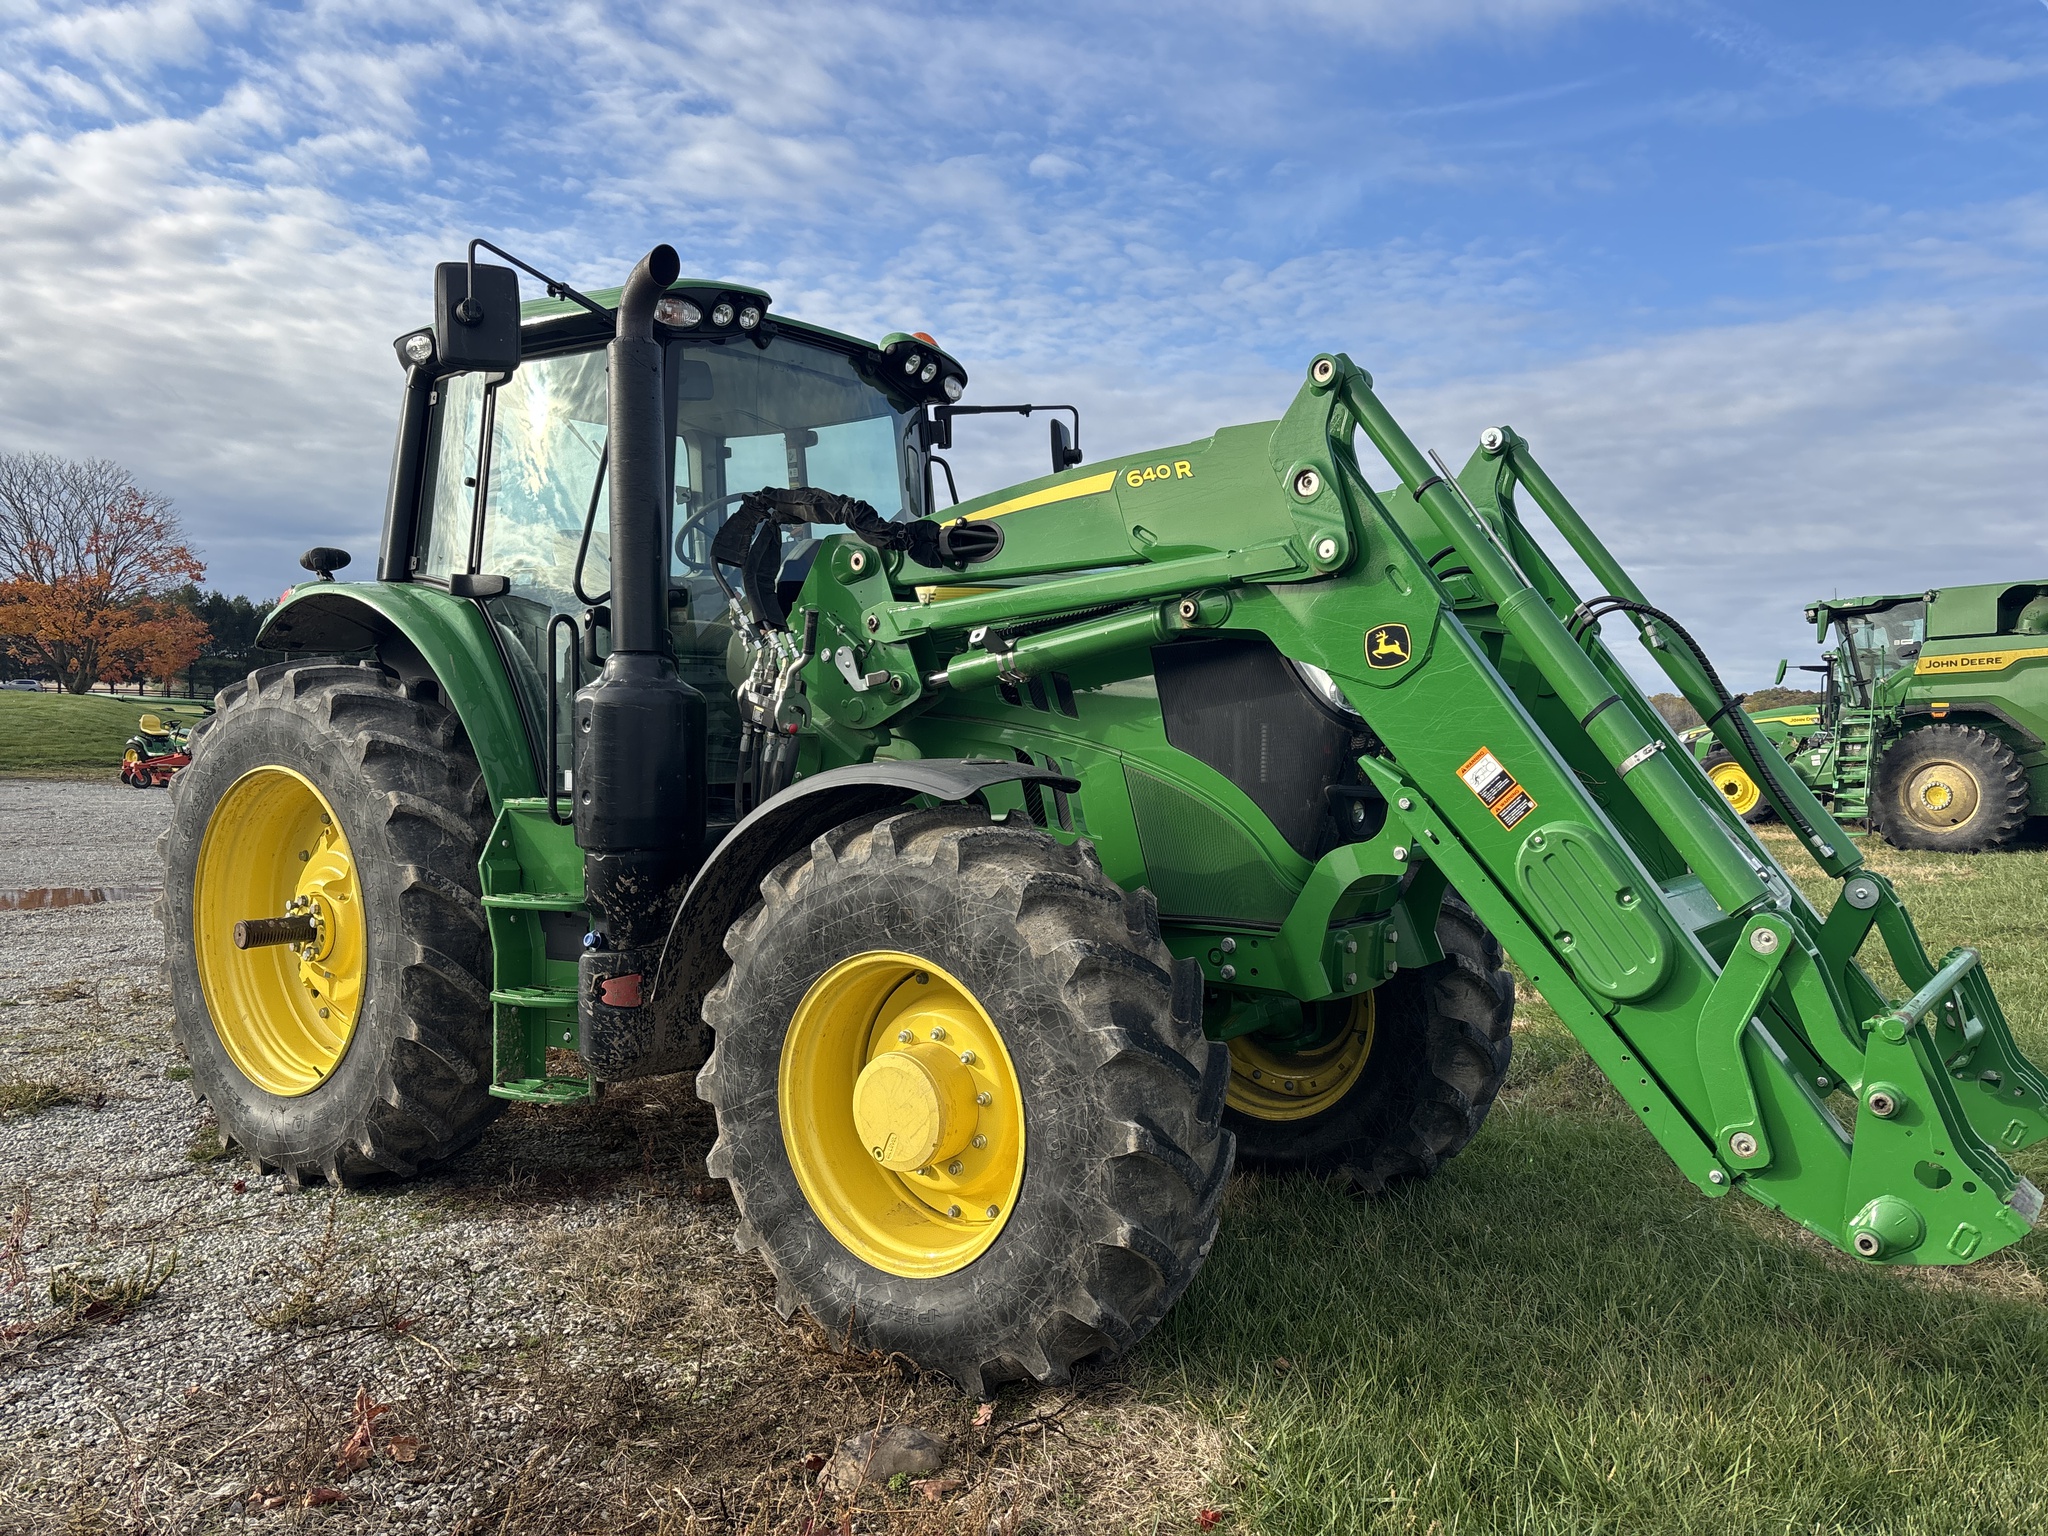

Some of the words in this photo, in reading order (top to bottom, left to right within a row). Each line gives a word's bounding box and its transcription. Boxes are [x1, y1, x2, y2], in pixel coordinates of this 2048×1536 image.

[1925, 660, 1958, 669] JOHN
[1960, 657, 2003, 667] DEERE
[1465, 751, 1485, 770] WARNING
[1500, 789, 1520, 808] WARNING
